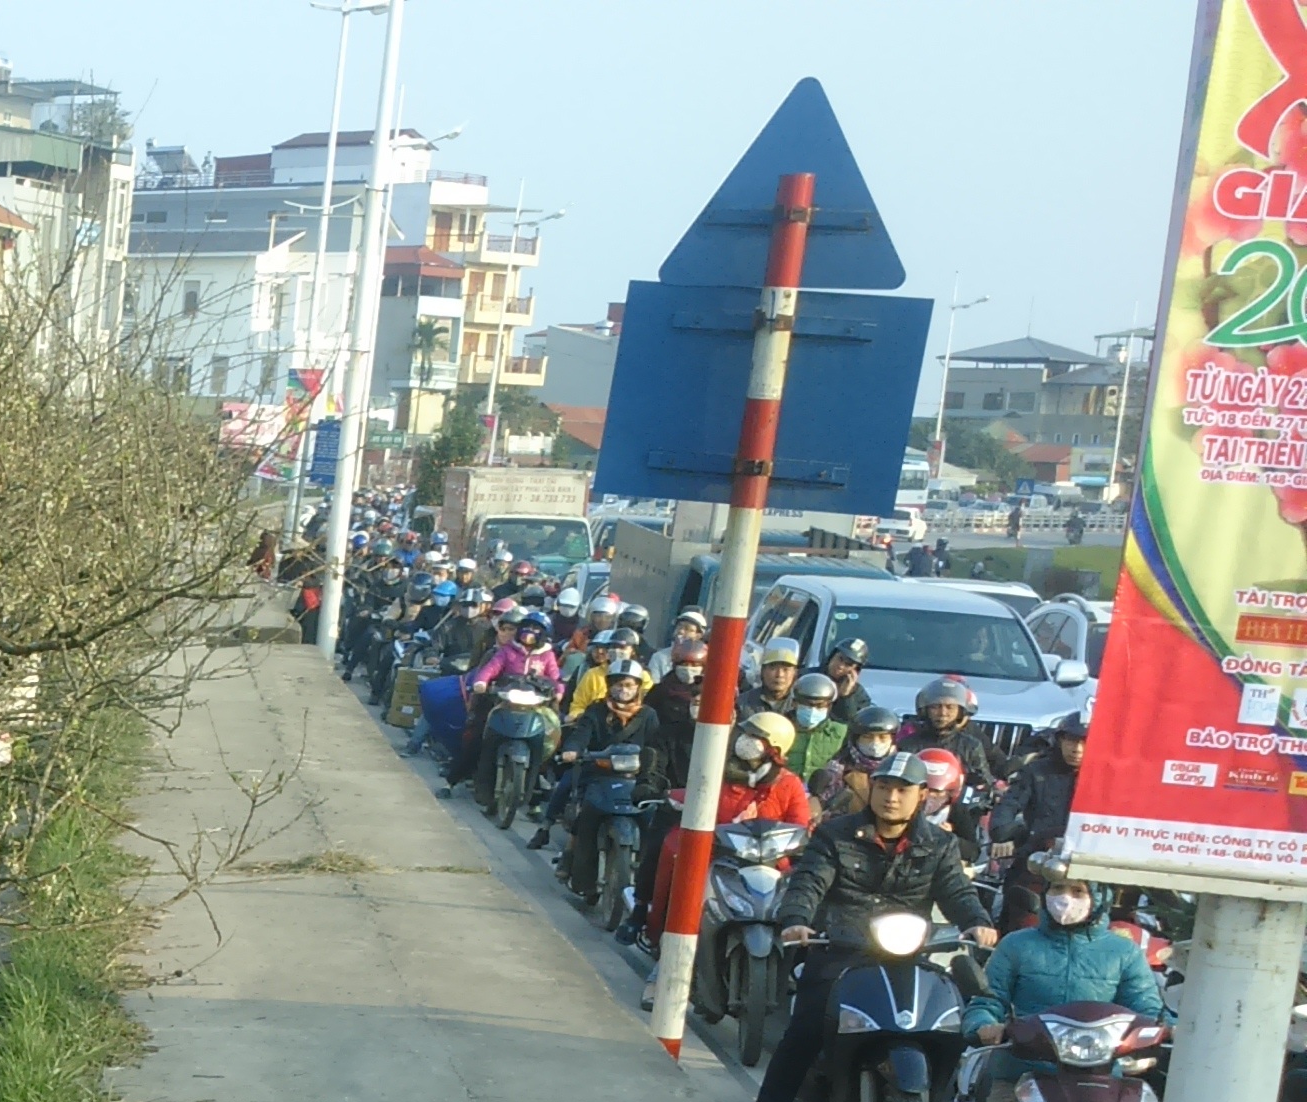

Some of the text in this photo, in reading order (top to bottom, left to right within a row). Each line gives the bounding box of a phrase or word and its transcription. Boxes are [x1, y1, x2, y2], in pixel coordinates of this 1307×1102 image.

[1214, 168, 1307, 219] GI
[1189, 363, 1222, 402] TỪ
[1221, 367, 1285, 405] NGÀY
[1220, 413, 1237, 425] 18
[1240, 408, 1272, 427] ĐẾN
[1275, 416, 1295, 429] 27
[1206, 431, 1305, 467] TẠI TRIỂN
[1236, 587, 1267, 605] TÀI
[1224, 653, 1282, 674] ĐỒNG
[1189, 727, 1230, 746] BẢO
[1236, 733, 1275, 753] TRỢ
[1212, 833, 1252, 848] CÔNG
[1257, 838, 1275, 849] TY
